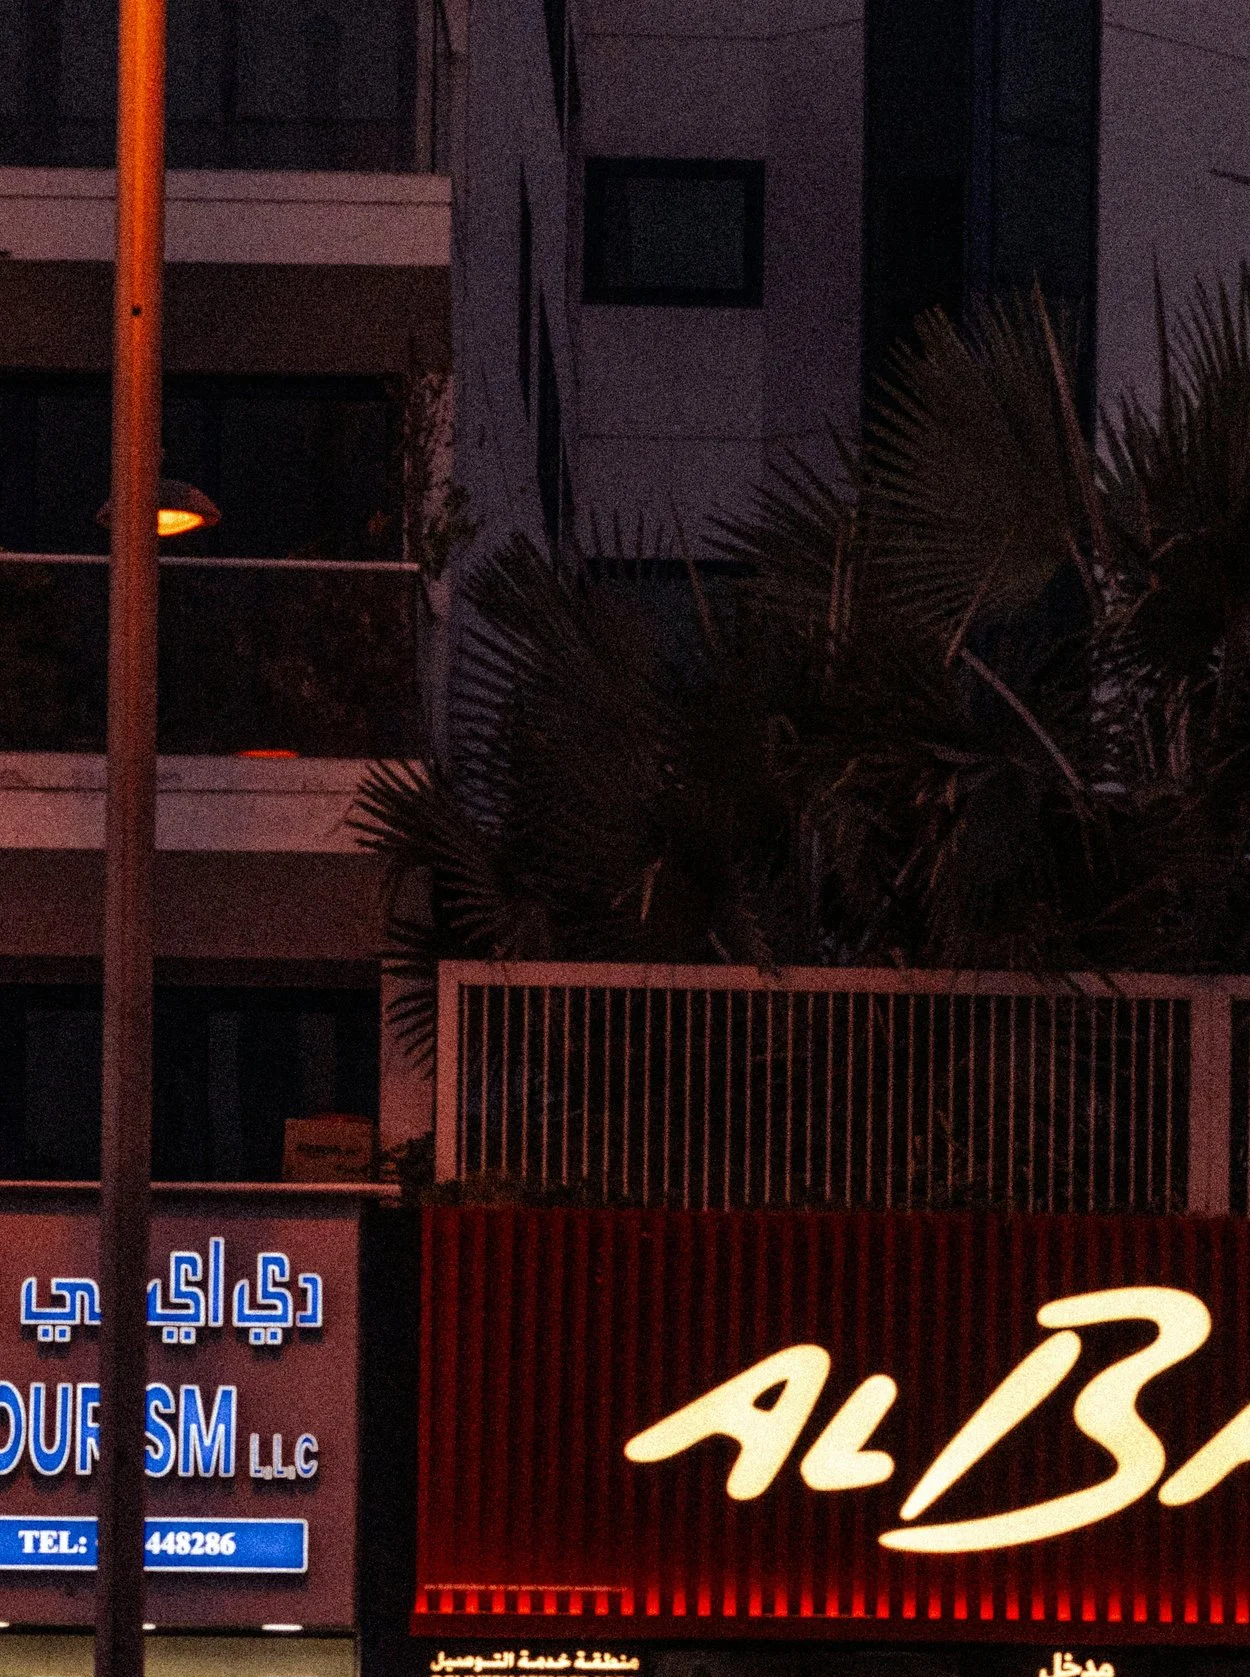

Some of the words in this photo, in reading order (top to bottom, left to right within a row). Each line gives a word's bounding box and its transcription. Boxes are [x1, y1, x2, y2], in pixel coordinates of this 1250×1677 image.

[20, 1276, 102, 1343] ي
[18, 1529, 88, 1555] TEL:
[96, 1530, 237, 1556] 448286
[516, 1650, 572, 1671] خدمة
[573, 1650, 640, 1671] منطقة
